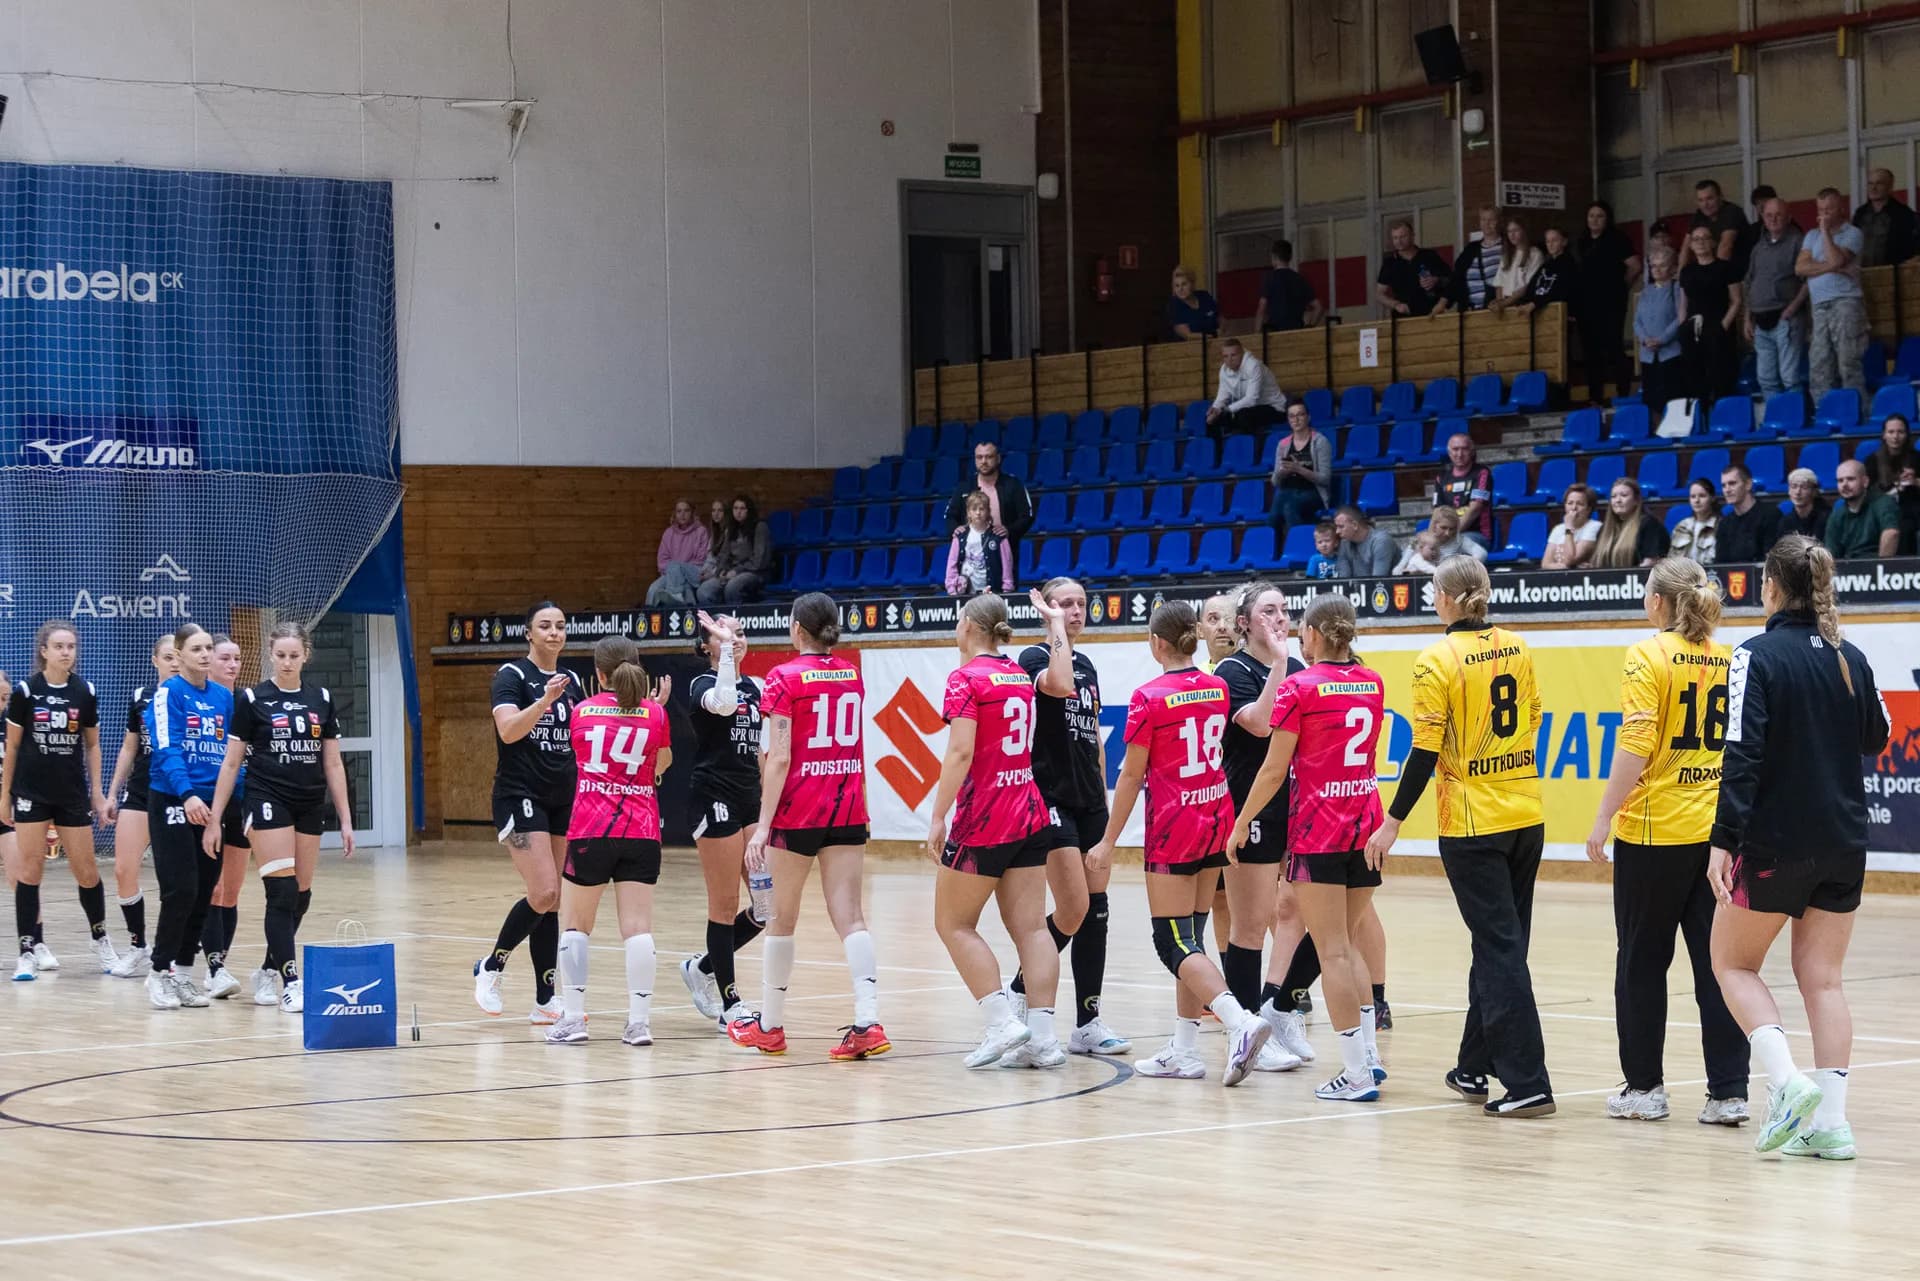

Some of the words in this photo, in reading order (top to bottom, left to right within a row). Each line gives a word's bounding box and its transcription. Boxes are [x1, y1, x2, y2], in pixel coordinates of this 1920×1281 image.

[1505, 184, 1560, 193] SEKTOR
[1506, 191, 1522, 205] B
[160, 272, 184, 289] CK
[70, 588, 192, 619] Aswent
[1476, 646, 1521, 663] LEWIATAN
[816, 671, 854, 680] LEWIATAN
[1181, 690, 1221, 702] LEWIATAN
[1334, 684, 1376, 693] LEWIATAN
[557, 702, 567, 722] 8
[1490, 673, 1519, 739] 8
[51, 711, 68, 729] 50
[202, 716, 215, 736] 25
[295, 715, 306, 733] 6
[807, 692, 862, 750] 10
[730, 727, 746, 742] SPR
[1344, 706, 1374, 767] 2
[270, 739, 288, 753] SPR
[583, 724, 650, 775] 14
[1178, 713, 1226, 778] 18
[1863, 773, 1881, 794] st
[165, 806, 186, 825] 25
[262, 802, 273, 821] 6
[522, 798, 534, 818] 8
[1250, 820, 1262, 844] 5
